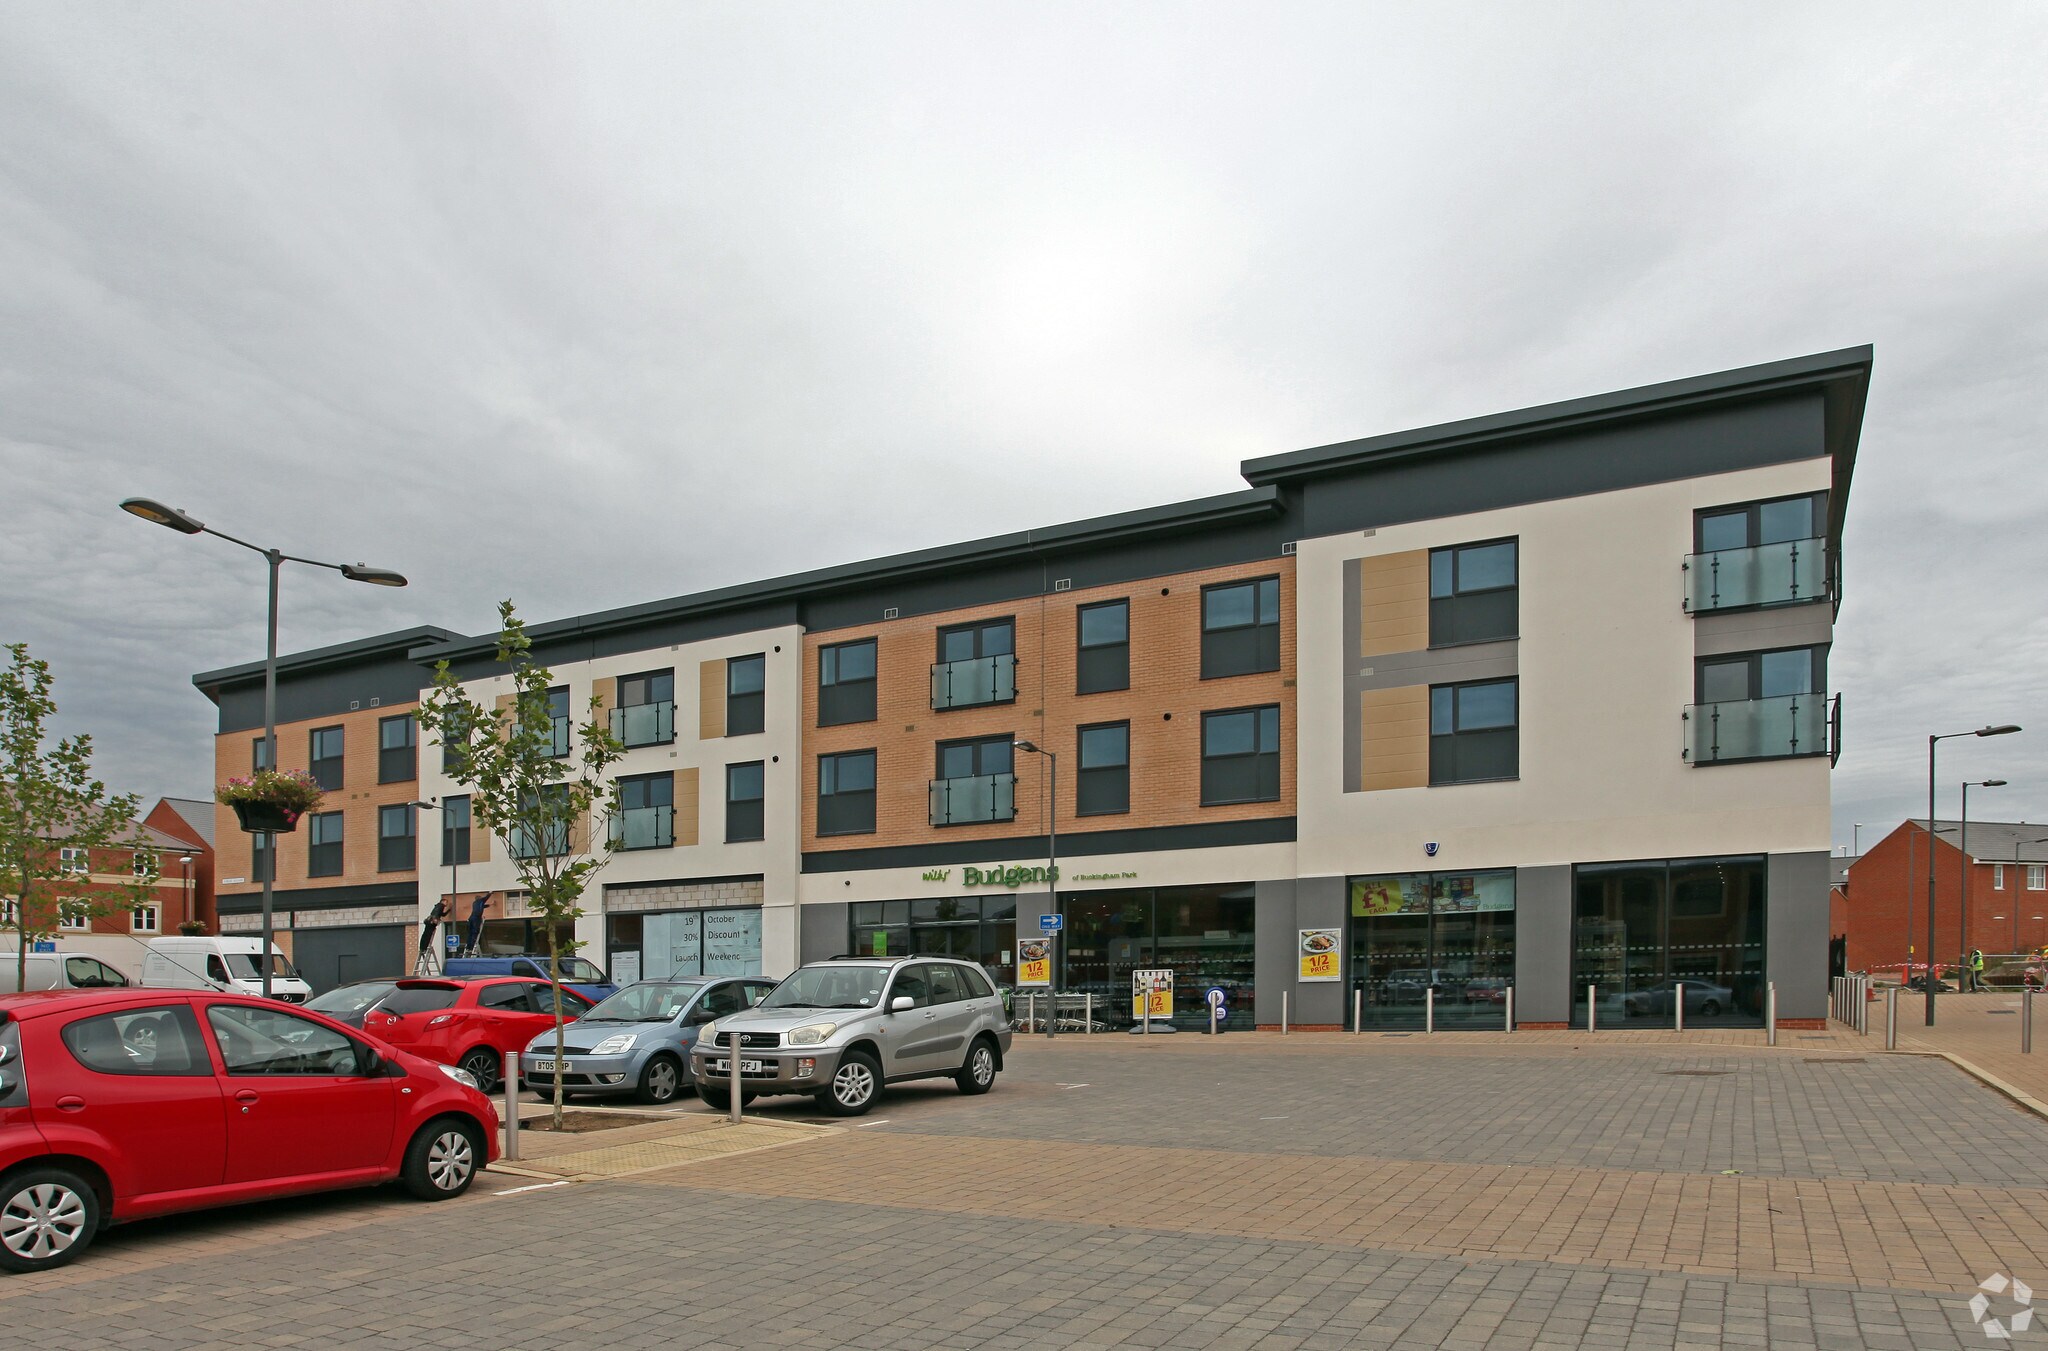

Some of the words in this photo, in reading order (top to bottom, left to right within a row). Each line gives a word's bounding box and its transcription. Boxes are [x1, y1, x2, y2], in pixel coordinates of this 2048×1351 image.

[962, 865, 1059, 888] Budgens
[1080, 873, 1120, 881] Buckingham
[1365, 881, 1383, 889] ALL
[1362, 888, 1389, 909] £1
[1368, 907, 1388, 915] EACH
[707, 915, 735, 924] October
[684, 933, 698, 942] 30%
[708, 931, 740, 940] Discount
[675, 953, 699, 963] Launch
[1309, 954, 1330, 967] 1/2
[1026, 961, 1043, 973] 1/2
[1310, 965, 1330, 973] PRICE
